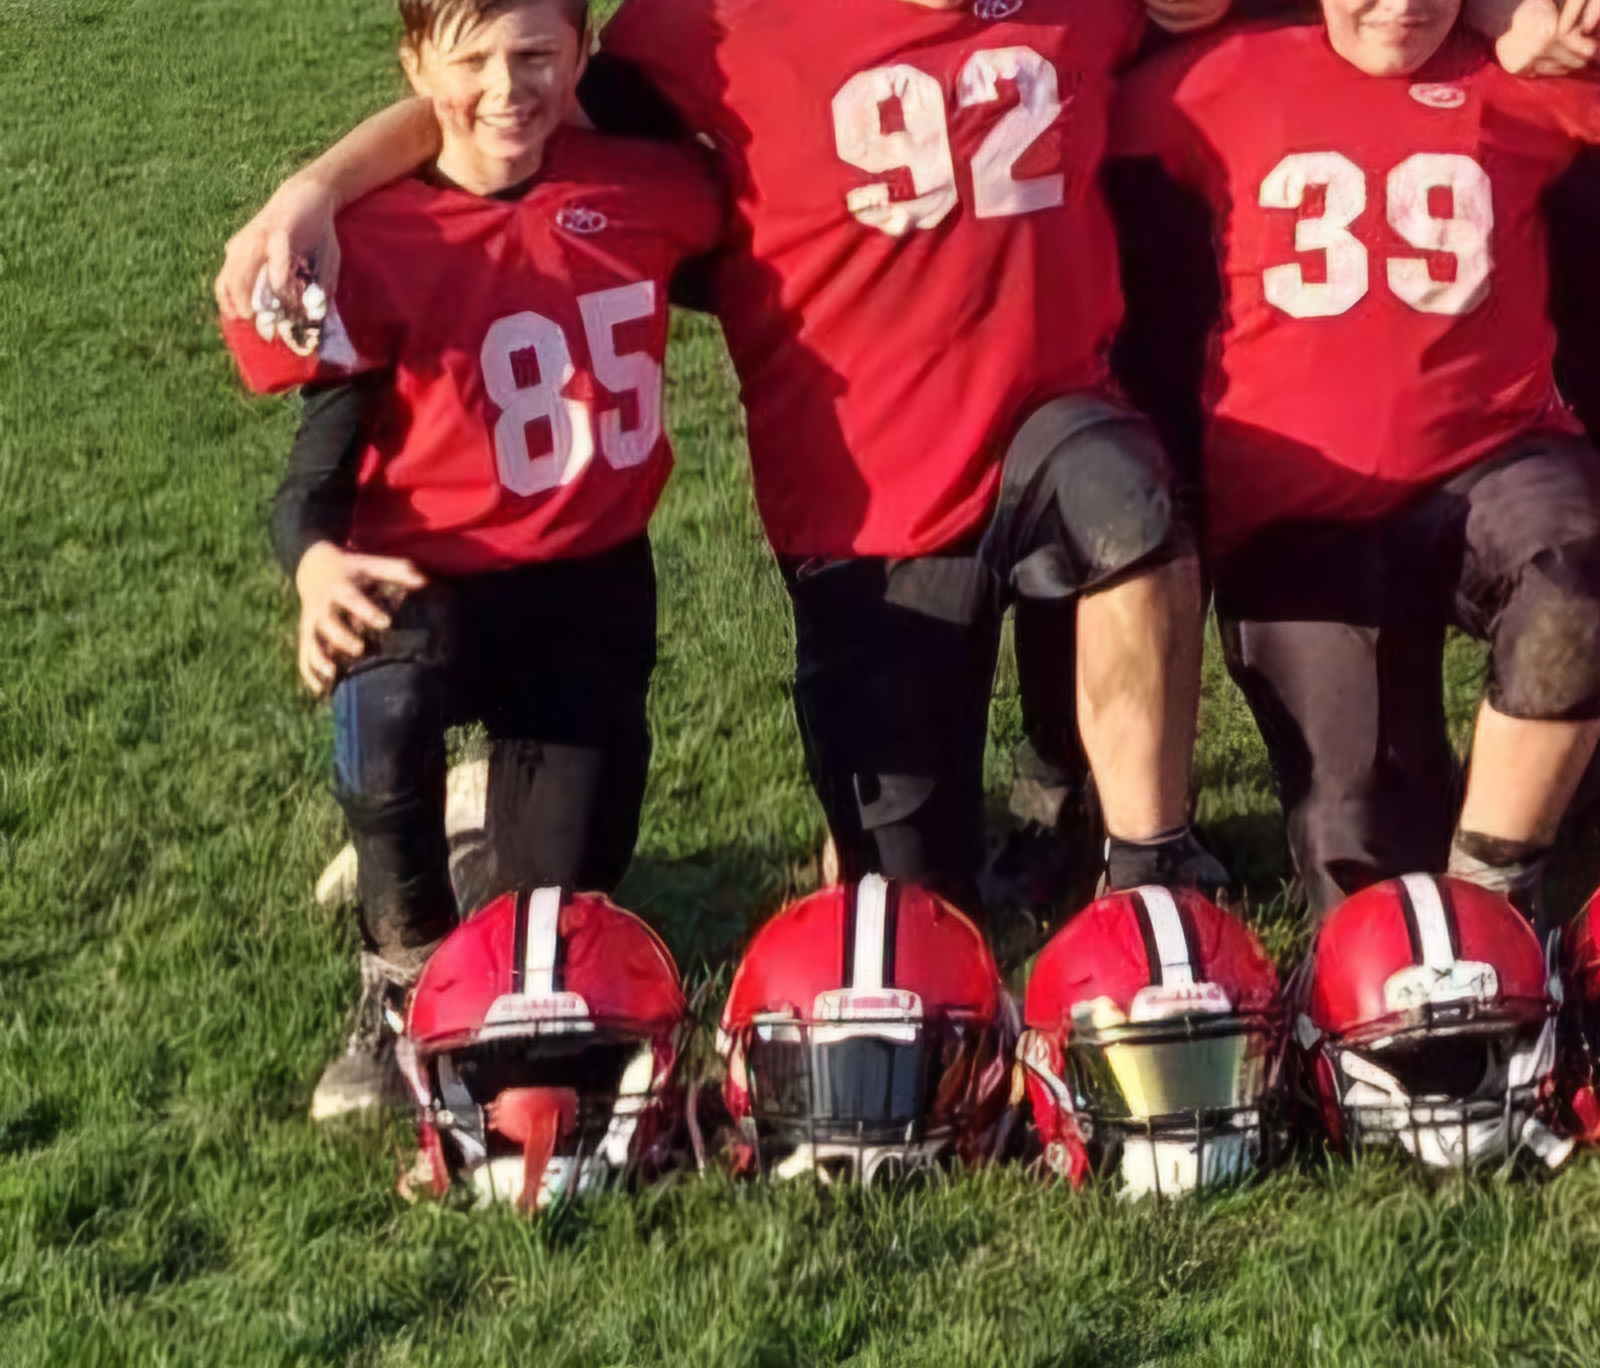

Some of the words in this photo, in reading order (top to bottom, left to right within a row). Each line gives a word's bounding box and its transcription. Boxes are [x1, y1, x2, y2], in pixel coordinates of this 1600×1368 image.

[831, 45, 1064, 237] 92
[1259, 151, 1495, 319] 39
[480, 280, 663, 497] 85
